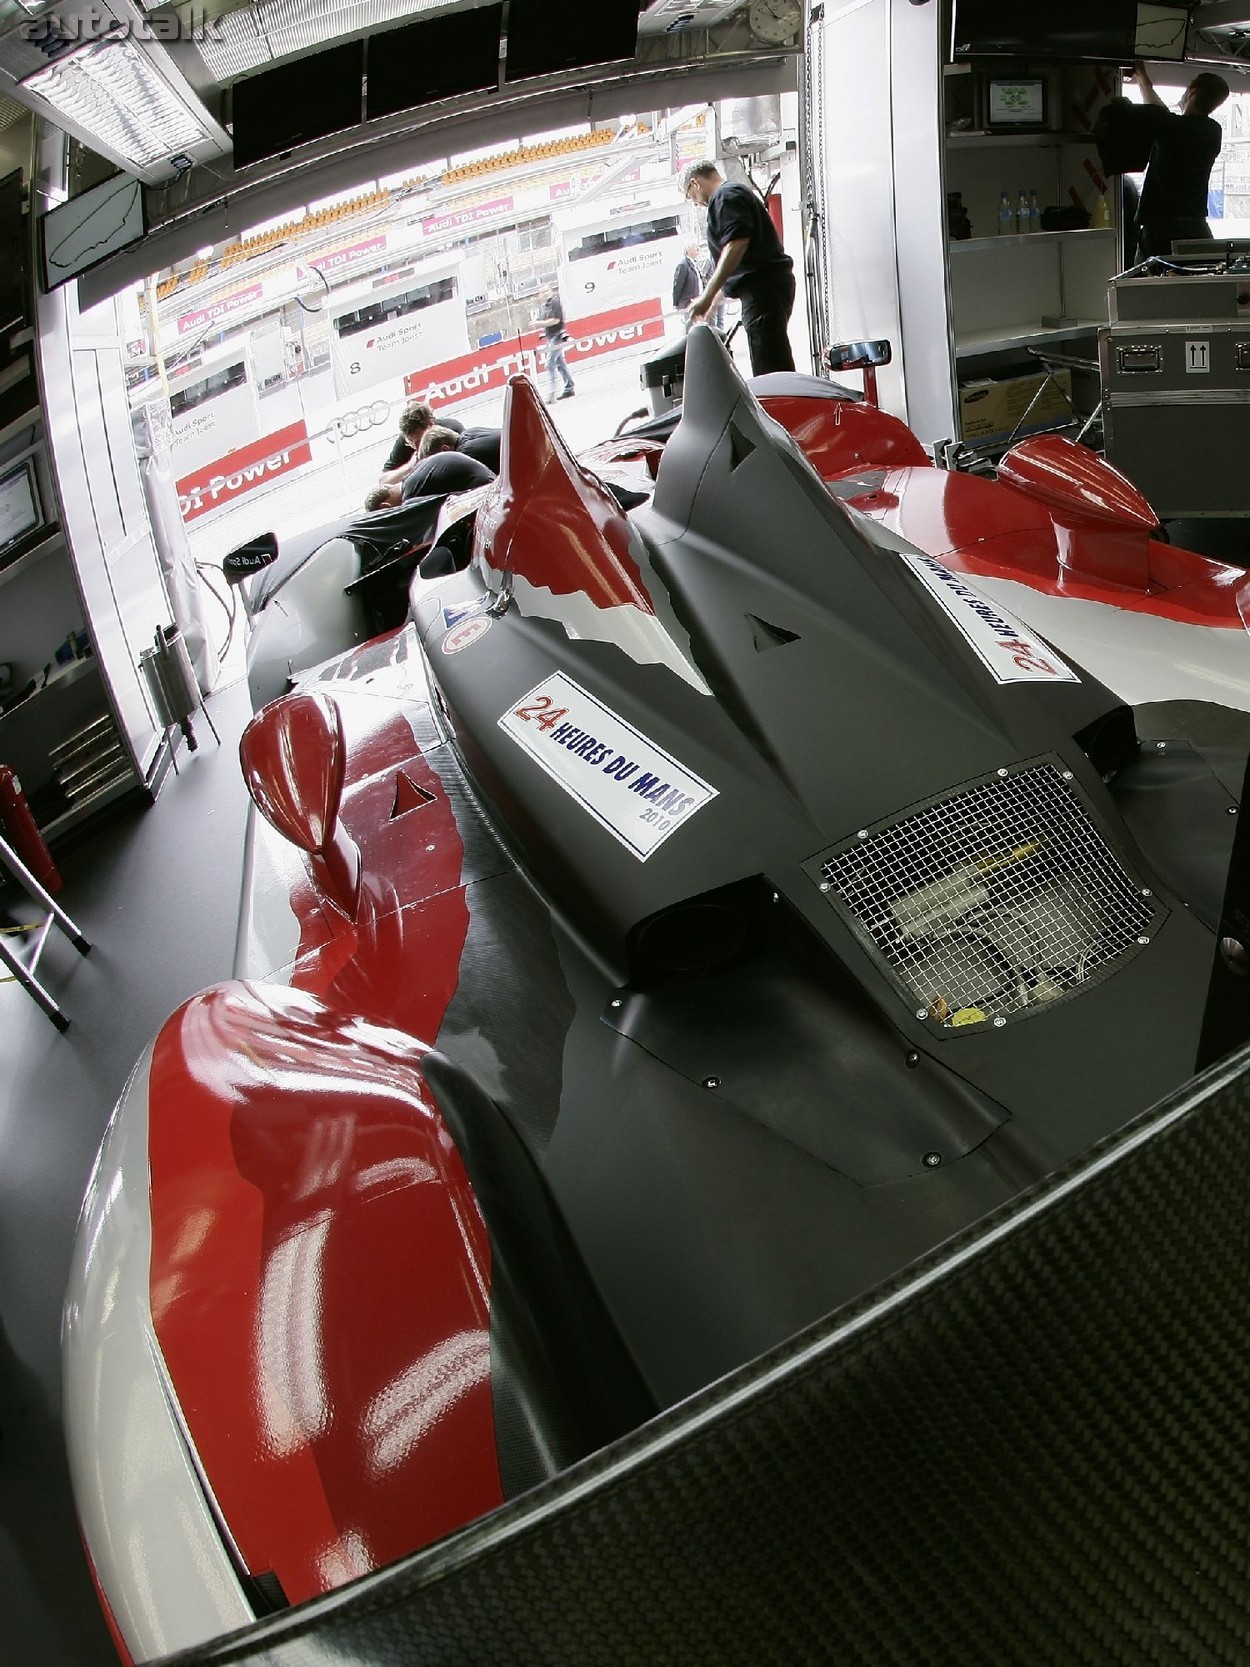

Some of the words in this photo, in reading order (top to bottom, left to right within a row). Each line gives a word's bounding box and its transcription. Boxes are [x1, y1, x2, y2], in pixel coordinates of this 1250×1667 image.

[427, 218, 452, 232] Audi
[455, 214, 473, 224] TDI
[476, 204, 509, 218] Power
[327, 255, 347, 266] TDI
[349, 243, 382, 259] Power
[617, 256, 636, 266] Audi
[639, 251, 662, 262] Sport
[584, 281, 596, 294] 9
[183, 314, 205, 330] Audi
[207, 306, 225, 318] TDI
[226, 291, 257, 310] Power
[376, 330, 396, 344] Audi
[398, 322, 422, 336] Sport
[349, 362, 361, 375] 8
[424, 363, 489, 403] Audi
[192, 412, 215, 427] Sport
[209, 452, 290, 499] Power
[946, 583, 977, 598] DU
[963, 598, 1018, 637] HEURES
[995, 639, 1060, 676] 24
[512, 695, 570, 732] 24
[549, 722, 614, 767] HEURES
[603, 756, 640, 783] DU
[628, 772, 695, 816] MANS
[639, 808, 671, 831] 2010
